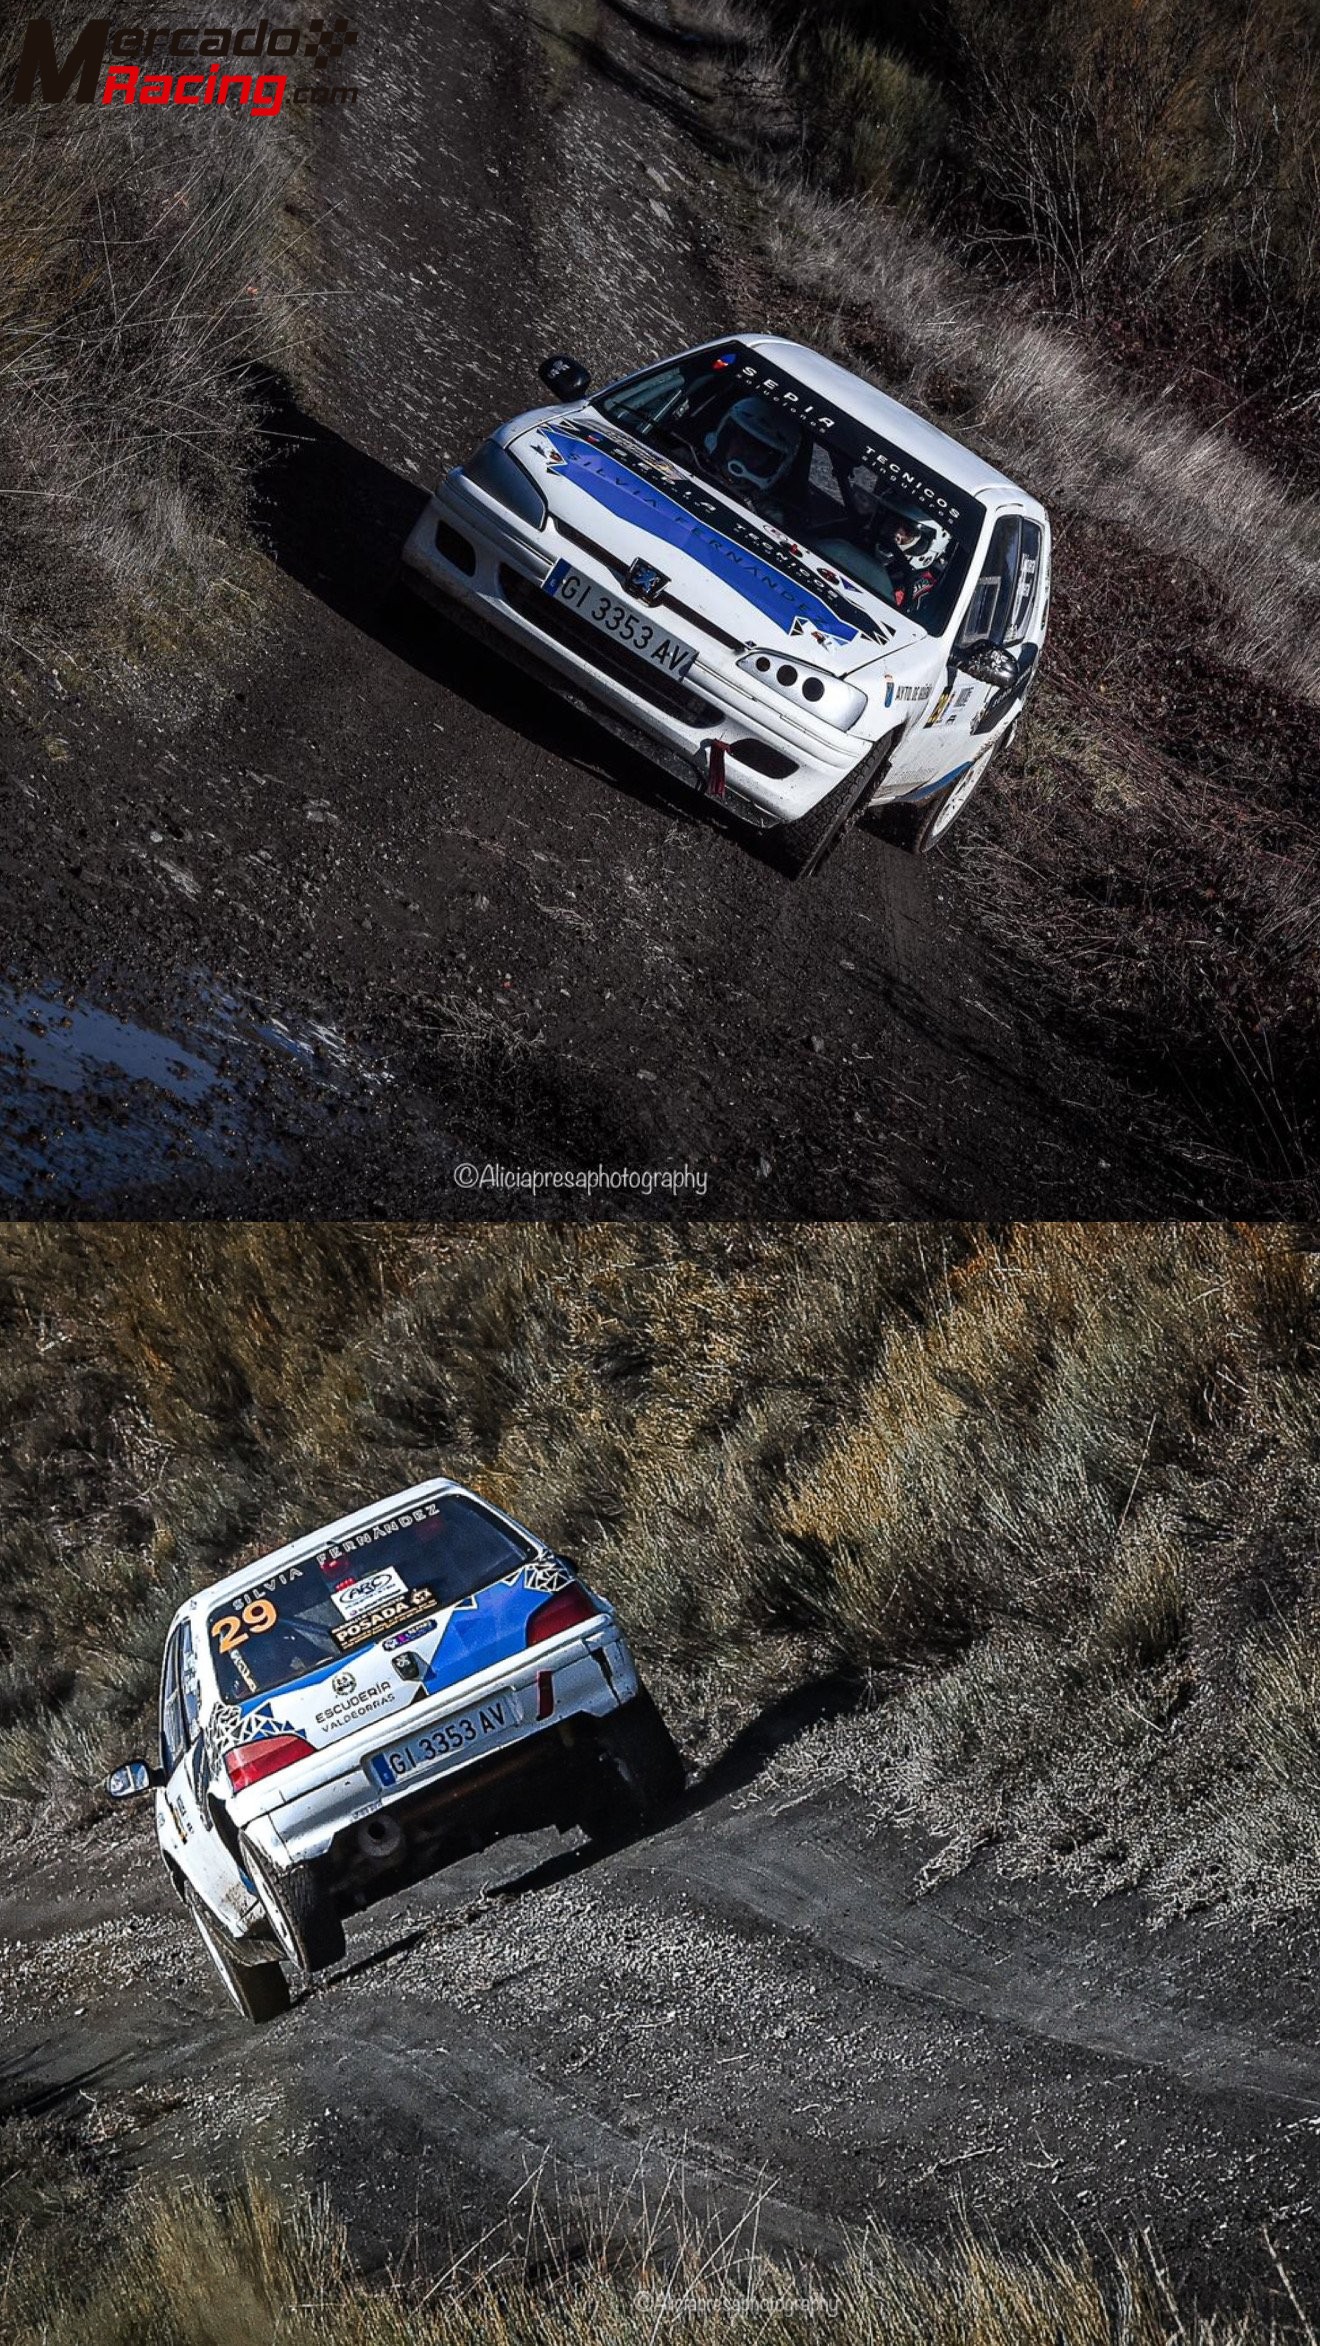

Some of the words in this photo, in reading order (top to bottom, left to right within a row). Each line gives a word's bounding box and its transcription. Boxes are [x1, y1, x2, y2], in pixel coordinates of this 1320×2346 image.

[742, 366, 836, 429] SEPIA
[865, 445, 961, 519] TECNICOS
[561, 575, 591, 608] GI
[591, 597, 654, 650] 3353
[651, 639, 690, 671] AV
[232, 1567, 304, 1611] SILVIA
[211, 1599, 278, 1654] 29
[336, 1602, 410, 1642] POSADA
[315, 1680, 391, 1724] ESCUDERÍA
[321, 1693, 396, 1733] VALDEORRAS
[389, 1747, 417, 1775] GI
[418, 1719, 477, 1761] 3353
[478, 1702, 506, 1734] AV
